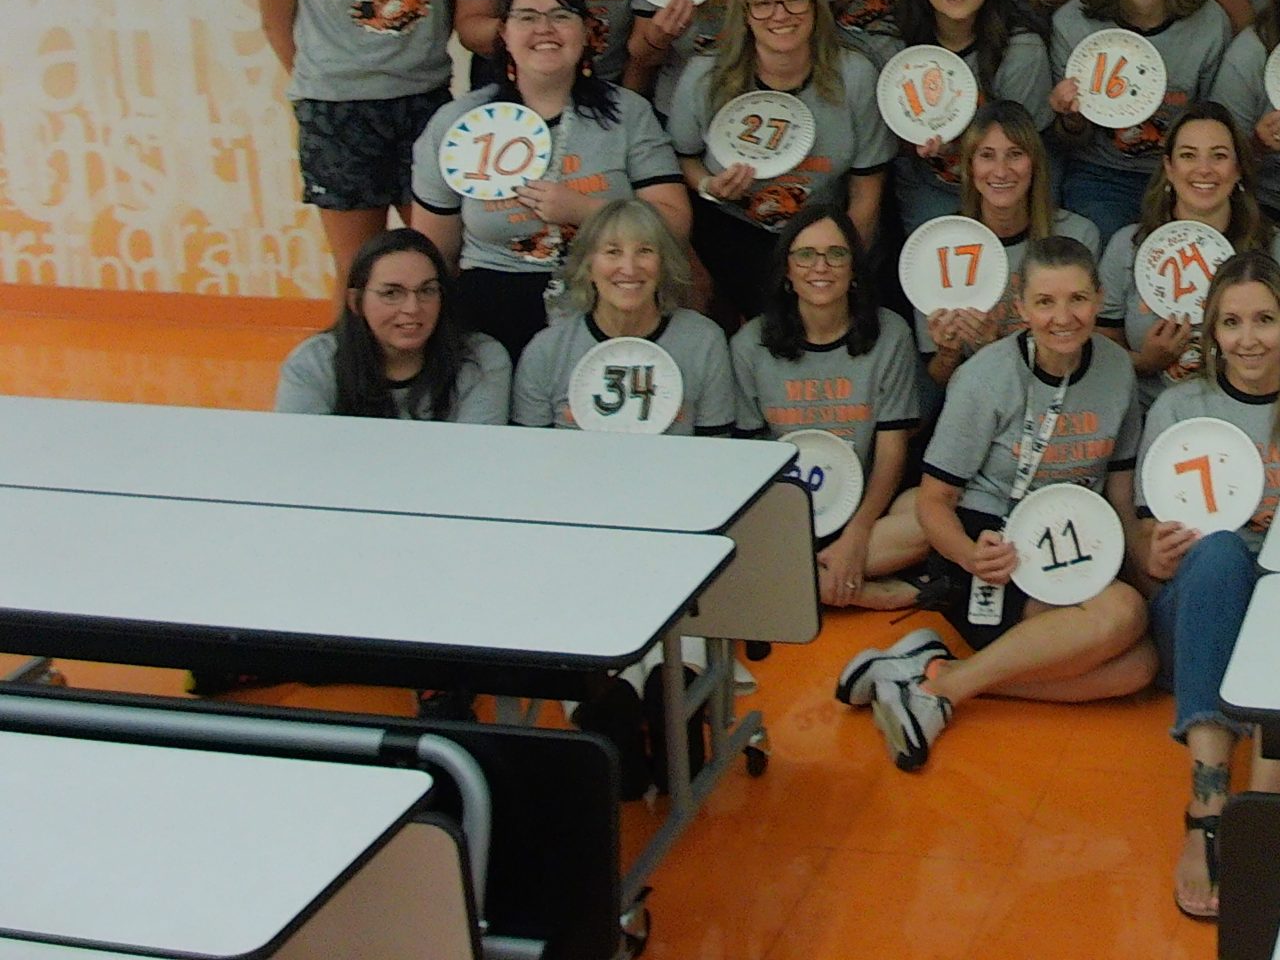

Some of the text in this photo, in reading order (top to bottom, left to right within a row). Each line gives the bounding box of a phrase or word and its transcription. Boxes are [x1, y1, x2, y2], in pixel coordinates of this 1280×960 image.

[1089, 52, 1128, 99] 16
[463, 132, 536, 181] 10
[739, 113, 792, 151] 27
[936, 243, 986, 290] 17
[1157, 240, 1219, 303] 24
[591, 364, 659, 421] 34
[1172, 454, 1219, 515] 7
[1036, 518, 1093, 572] 11
